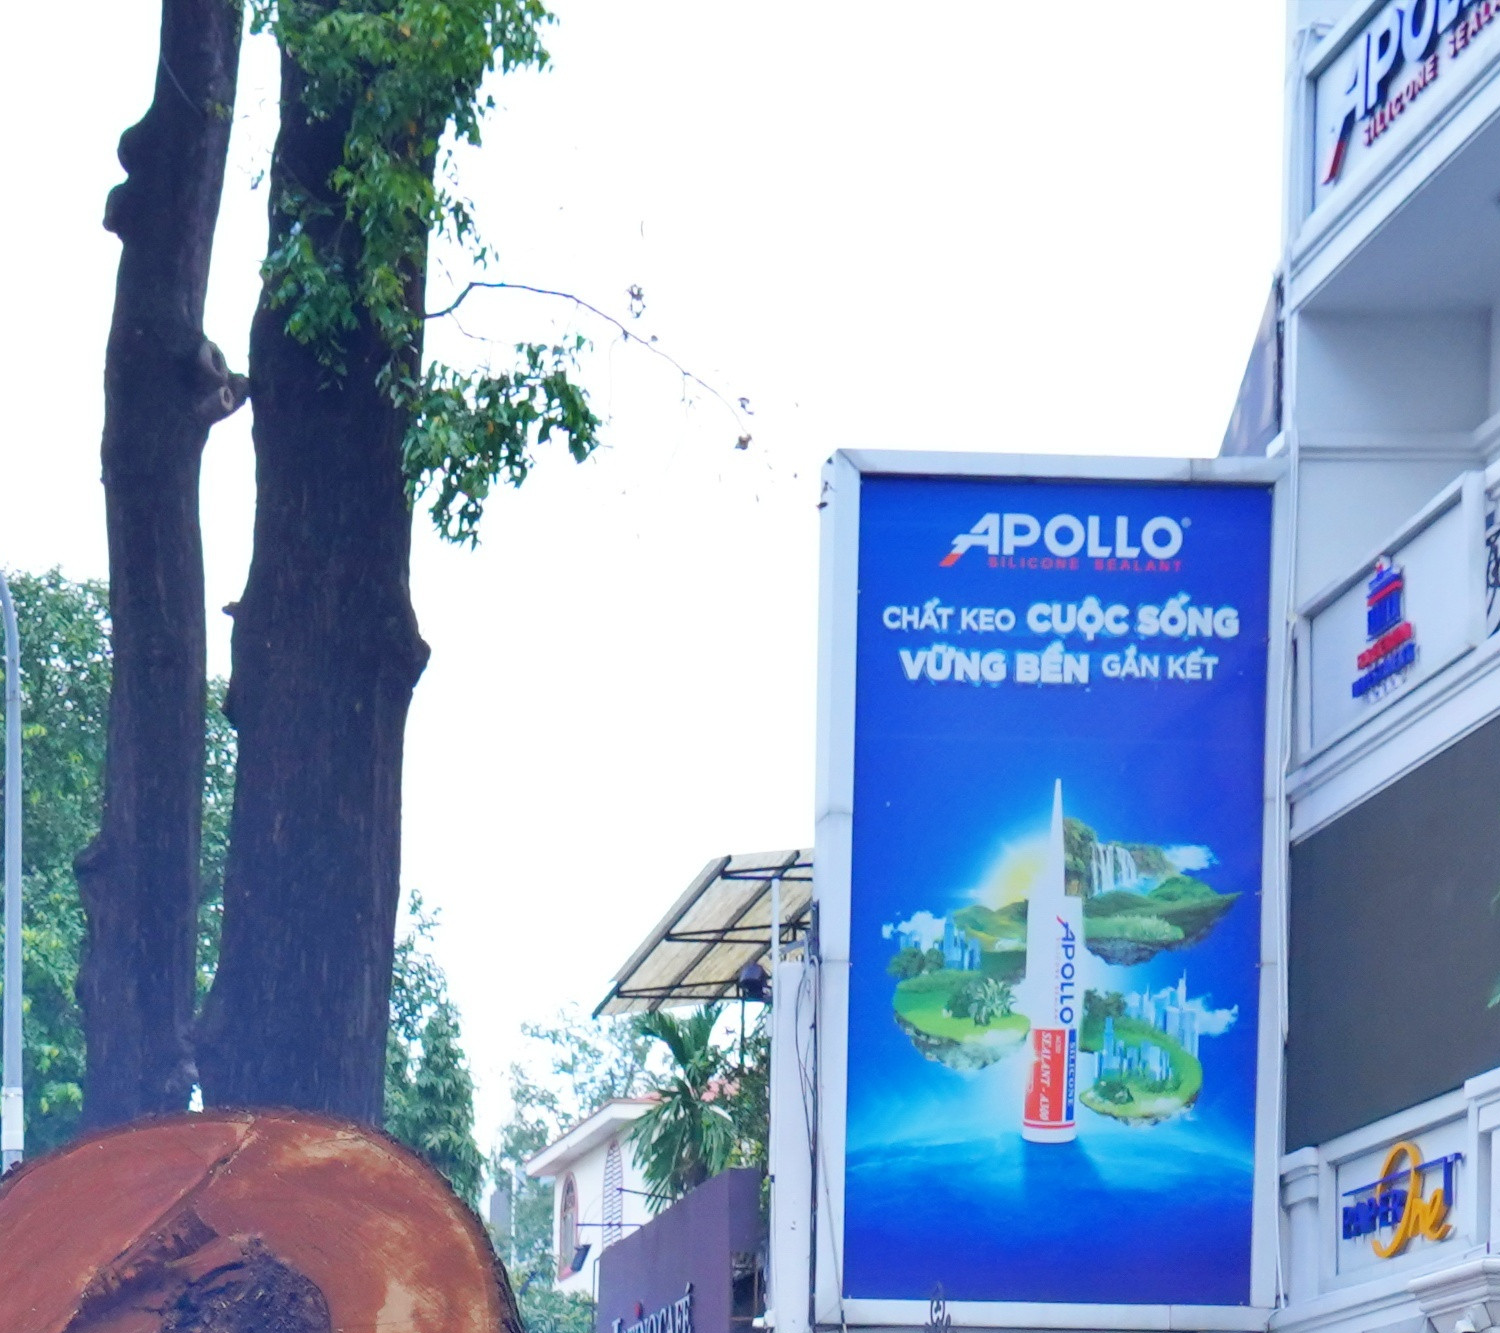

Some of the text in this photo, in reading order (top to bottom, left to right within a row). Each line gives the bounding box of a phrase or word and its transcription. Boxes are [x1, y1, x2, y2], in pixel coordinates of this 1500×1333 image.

[1322, 0, 1478, 185] APO
[940, 513, 1183, 567] APOLLO
[988, 556, 1183, 572] SILICONE SEALANT
[883, 591, 1239, 640] CHẤT KEO CUỘC SỐNG
[900, 643, 1007, 683] VỮNG
[1168, 647, 1219, 681] KẾT
[1056, 914, 1076, 1025] APOLLO
[1040, 1031, 1052, 1088] SEALANT
[1066, 1042, 1076, 1106] SILICONE
